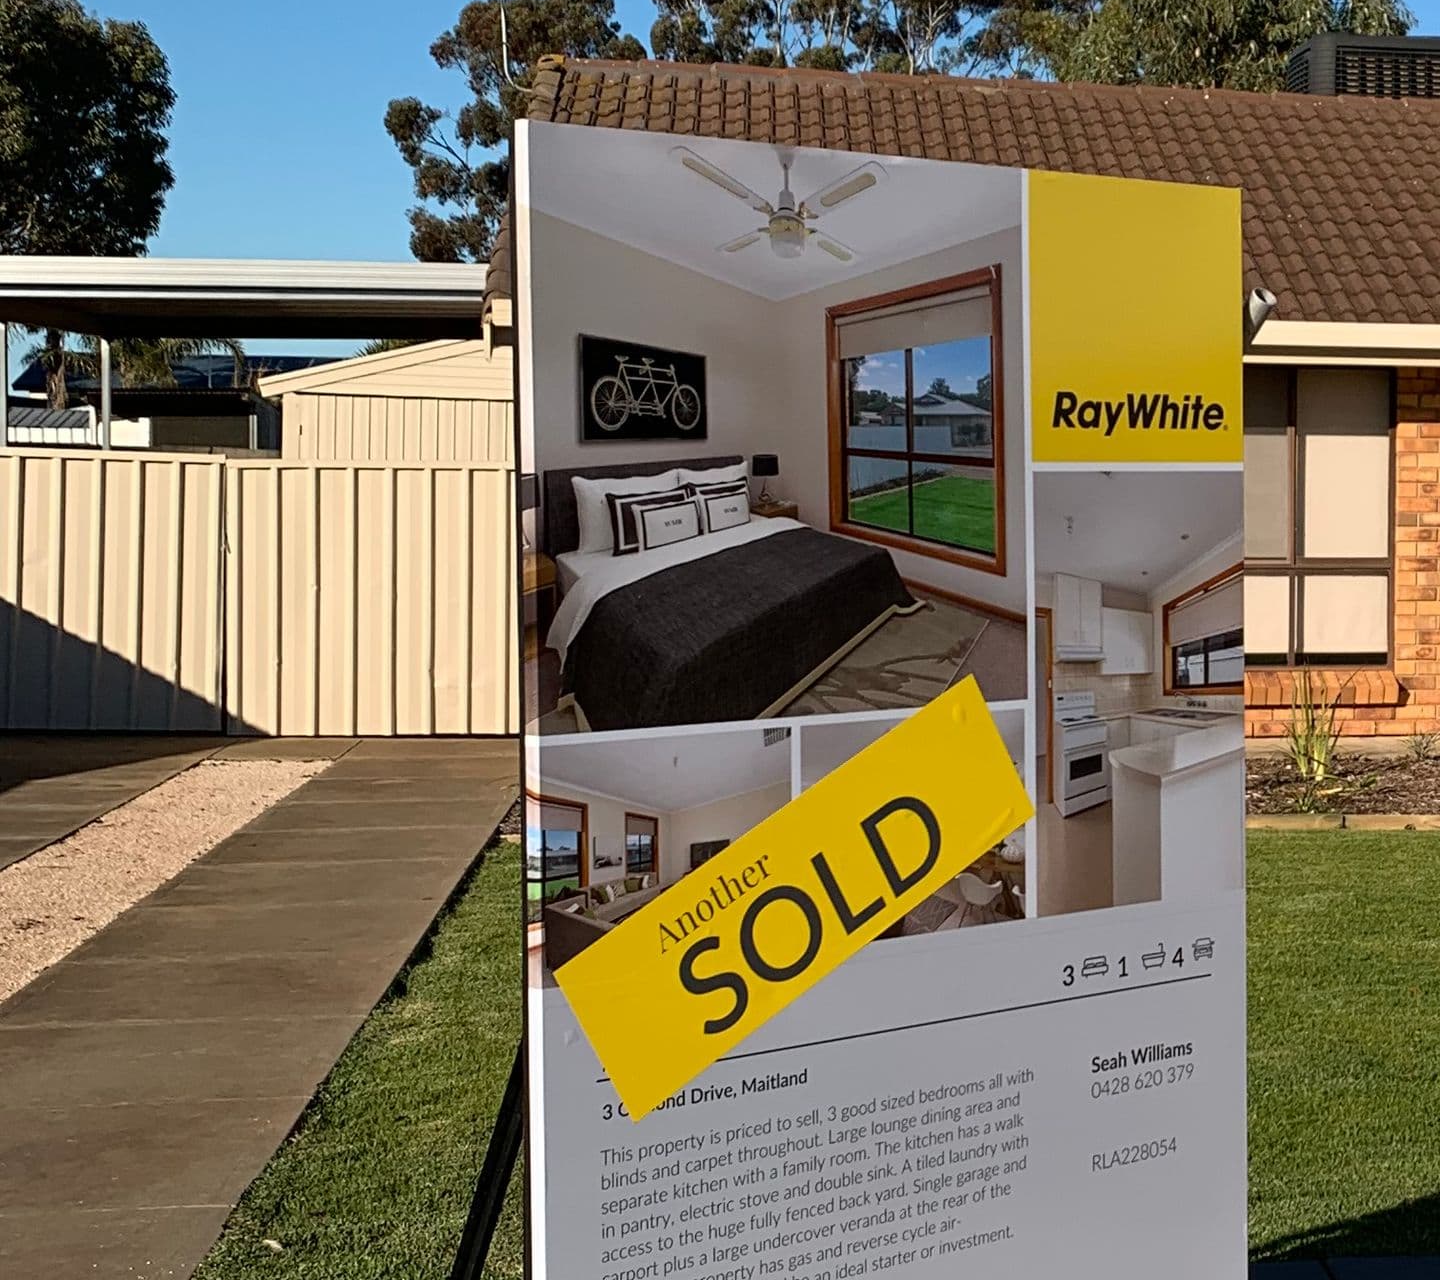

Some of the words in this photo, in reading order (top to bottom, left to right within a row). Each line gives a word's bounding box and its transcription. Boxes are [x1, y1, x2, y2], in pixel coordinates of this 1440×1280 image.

[656, 854, 772, 954] Another
[679, 796, 941, 1035] SOLD
[1063, 965, 1075, 986] 3
[1118, 956, 1129, 978] 1
[1172, 947, 1184, 968] 4
[602, 1104, 613, 1120] 3
[691, 1084, 736, 1104] Drive,
[741, 1067, 807, 1095] Maitland
[1091, 1051, 1127, 1073] Seah
[1130, 1042, 1193, 1065] Williams
[1091, 1075, 1130, 1099] 0428
[1134, 1069, 1163, 1090] 620
[1167, 1062, 1194, 1083] 379
[600, 1146, 633, 1166] This
[638, 1134, 705, 1162] property
[710, 1129, 721, 1144] is
[726, 1118, 771, 1146] priced
[777, 1117, 792, 1132] to
[796, 1108, 823, 1128] sell,
[827, 1105, 837, 1121] 3
[840, 1097, 876, 1122] good
[880, 1090, 915, 1111] sized
[919, 1080, 985, 1103] bedrooms
[989, 1073, 1002, 1090] all
[1006, 1068, 1034, 1085] with
[601, 1167, 647, 1190] blinds
[652, 1159, 680, 1180] and
[685, 1150, 733, 1173] carpet
[738, 1133, 823, 1163] throughout.
[828, 1126, 867, 1144] Large
[871, 1116, 917, 1135] lounge
[920, 1106, 961, 1125] dining
[964, 1101, 992, 1116] area
[996, 1091, 1020, 1110] and
[601, 1189, 668, 1215] separate
[673, 1177, 727, 1200] kitchen
[732, 1167, 765, 1186] with
[769, 1167, 777, 1179] a
[783, 1155, 826, 1176] family
[830, 1149, 870, 1167] room.
[874, 1141, 901, 1157] The
[905, 1131, 953, 1151] kitchen
[958, 1125, 979, 1140] has
[983, 1123, 991, 1134] a
[994, 1113, 1024, 1132] walk
[1092, 1137, 1177, 1172] RLA228054
[601, 1223, 615, 1239] in
[621, 1213, 674, 1239] pantry,
[679, 1197, 734, 1222] electric
[739, 1190, 779, 1210] stove
[783, 1179, 810, 1200] and
[814, 1170, 863, 1193] double
[867, 1162, 897, 1182] sink.
[901, 1158, 912, 1174] A
[916, 1150, 945, 1171] tiled
[949, 1142, 997, 1164] laundry
[1001, 1134, 1029, 1152] with
[601, 1241, 653, 1263] access
[657, 1236, 673, 1251] to
[679, 1229, 703, 1246] the
[708, 1221, 745, 1240] huge
[750, 1211, 781, 1230] fully
[786, 1197, 834, 1223] fenced
[839, 1190, 870, 1210] back
[874, 1181, 908, 1205] yard.
[913, 1173, 952, 1194] Single
[956, 1164, 999, 1187] garage
[1003, 1154, 1026, 1174] and
[663, 1255, 694, 1277] plus
[699, 1253, 707, 1266] a
[712, 1243, 749, 1262] large
[753, 1223, 836, 1253] undercover
[840, 1208, 895, 1233] veranda
[899, 1204, 912, 1220] at
[917, 1200, 939, 1216] the
[943, 1193, 968, 1209] rear
[972, 1185, 986, 1203] of
[990, 1183, 1011, 1198] the
[759, 1259, 784, 1275] has
[788, 1252, 812, 1271] gas
[816, 1241, 842, 1262] and
[847, 1232, 898, 1255] reverse
[901, 1220, 936, 1243] cycle
[940, 1216, 960, 1232] air-
[835, 1258, 867, 1280] ideal
[872, 1249, 917, 1271] starter
[920, 1245, 935, 1259] or
[939, 1225, 1013, 1255] investment.
